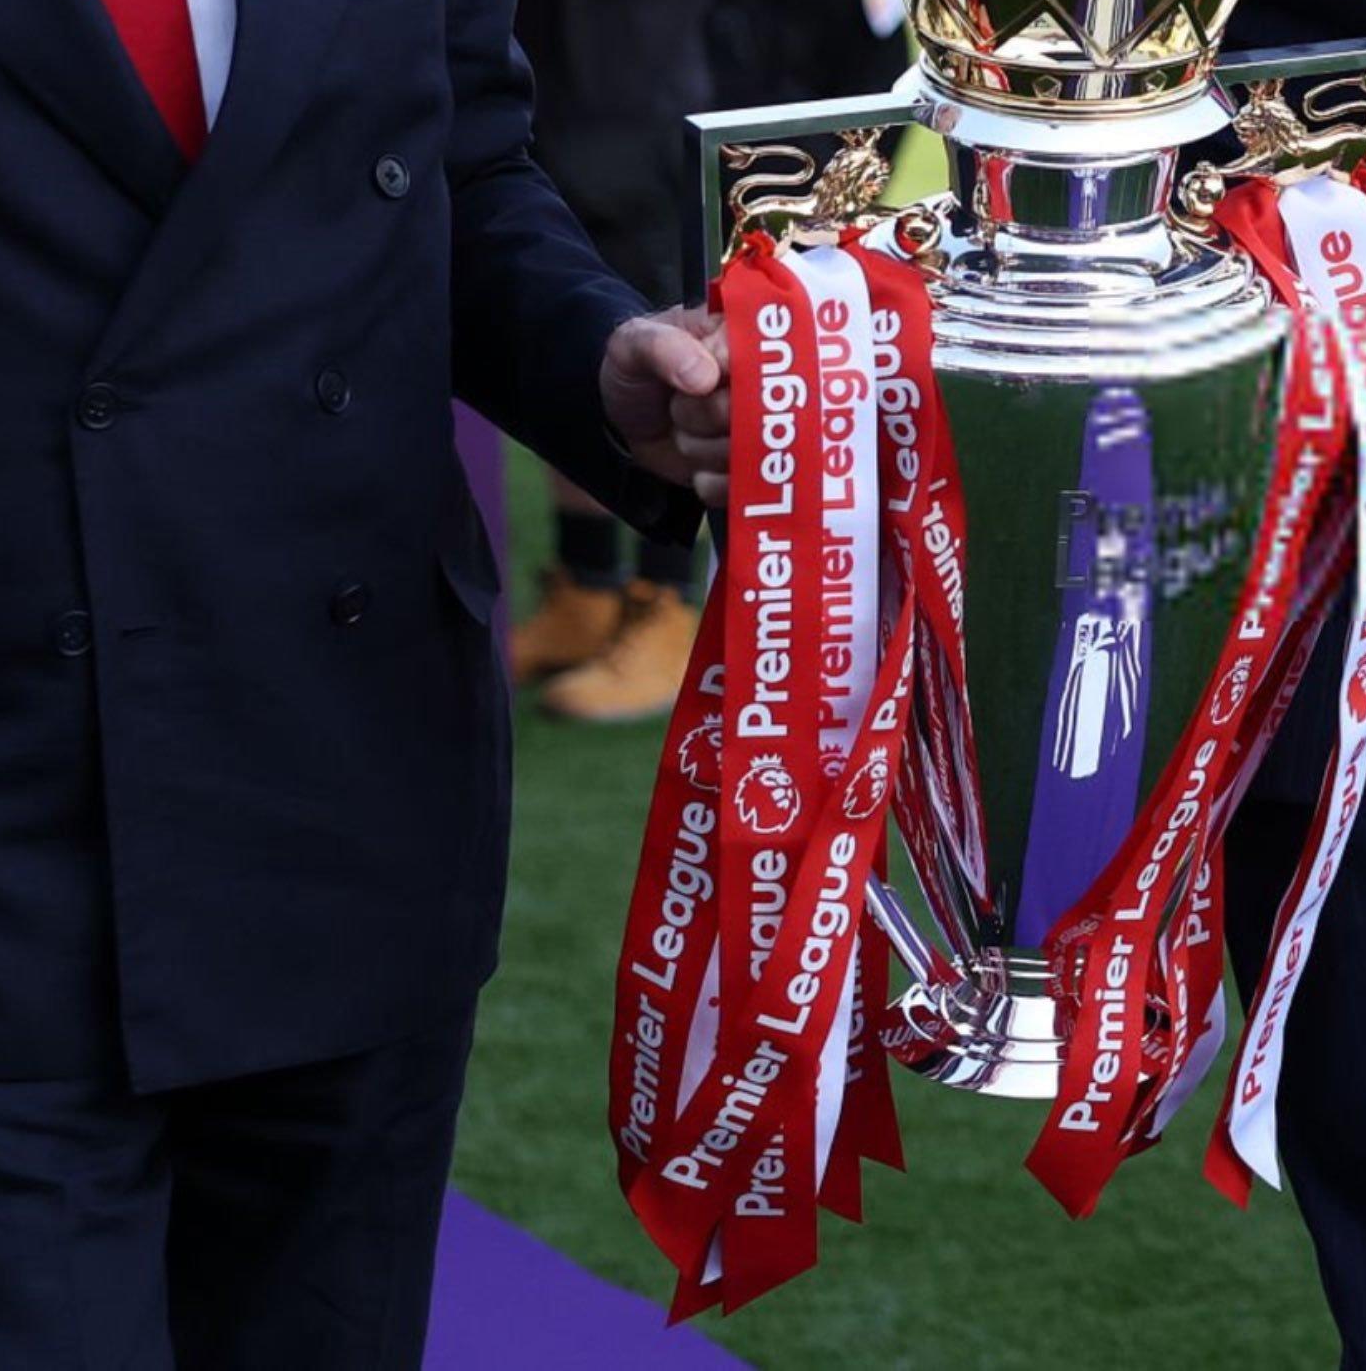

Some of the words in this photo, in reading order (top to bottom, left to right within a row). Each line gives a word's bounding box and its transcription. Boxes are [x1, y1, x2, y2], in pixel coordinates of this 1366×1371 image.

[745, 302, 808, 517] League
[817, 298, 869, 509] League
[873, 308, 922, 513] League
[737, 532, 793, 738] Premier
[817, 526, 855, 728] Premier
[633, 801, 716, 992] League
[750, 849, 788, 982] gue
[1059, 934, 1134, 1132] Premier
[1114, 739, 1217, 923] League
[620, 996, 667, 1161] Premier
[661, 1041, 788, 1189] Premier
[756, 831, 856, 1035] League
[1240, 926, 1304, 1106] Premier
